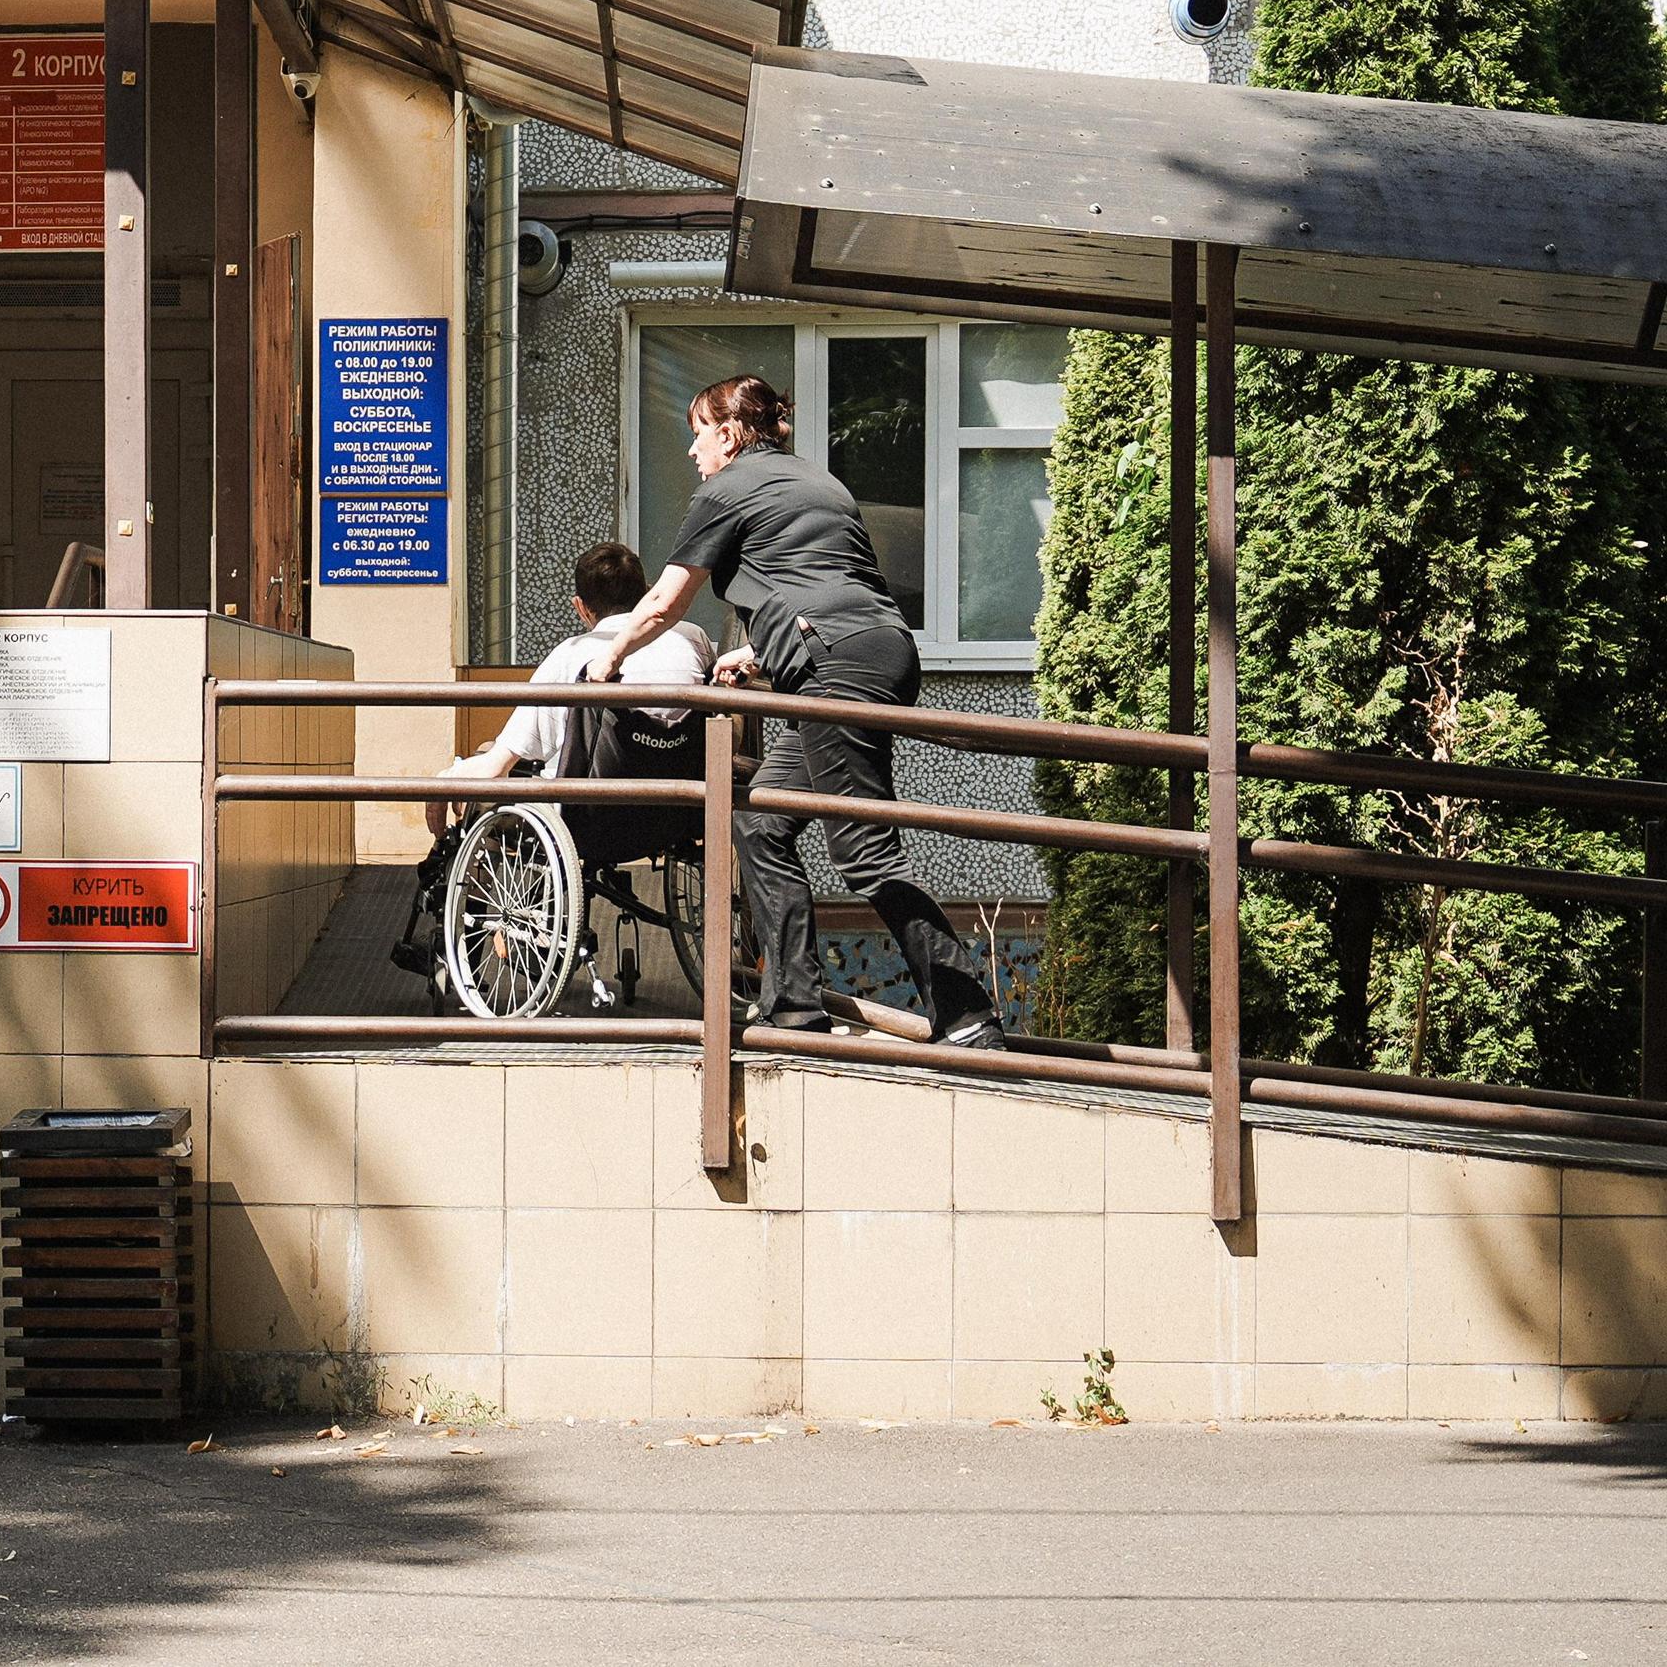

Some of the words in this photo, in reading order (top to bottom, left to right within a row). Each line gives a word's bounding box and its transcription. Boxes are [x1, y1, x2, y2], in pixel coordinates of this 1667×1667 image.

[12, 48, 26, 77] 2
[21, 232, 41, 245] ВХОД
[42, 233, 48, 244] В
[48, 231, 83, 245] ДНЕВНОЙ
[329, 326, 377, 337] РЕЖИМ
[381, 325, 437, 337] РАБОТЫ
[333, 340, 436, 352] ПОЛИКЛИНИКИ:
[335, 359, 342, 368] с
[345, 357, 378, 368] 08.00
[380, 359, 397, 369] до
[401, 357, 433, 367] 19.00
[340, 371, 427, 384] ЕЖЕДНЕВНО.
[342, 386, 424, 401] ВЫХОДНОЙ:
[350, 406, 415, 419] СУББОТА,
[333, 421, 432, 432] ВОСКРЕСЕНЬЕ
[334, 442, 361, 452] ВХОД
[363, 442, 370, 451] В
[372, 442, 432, 452] СТАЦИОНАР
[354, 454, 388, 462] ПОСЛЕ
[391, 454, 415, 462] 18.00
[331, 465, 338, 473] И
[341, 465, 348, 473] В
[350, 465, 408, 474] ВЫХОДНЫЕ
[411, 465, 432, 474] ДНИ
[324, 476, 332, 485] С
[334, 475, 387, 485] ОБРАТНОЙ
[389, 476, 441, 485] СТОРОНЫ!
[337, 502, 378, 511] РЕЖИМ
[381, 502, 429, 511] РАБОТЫ
[337, 514, 428, 523] РЕГИСТРАТУРЫ:
[346, 528, 416, 537] ежедневно
[332, 542, 340, 550] с
[343, 540, 375, 551] 06.30
[377, 542, 395, 551] до
[398, 540, 430, 551] 19.00
[355, 557, 411, 566] выходной:
[327, 568, 371, 578] суббота,
[373, 569, 439, 578] воскресенье
[4, 634, 49, 642] КОРПУС
[73, 878, 145, 895] КУРИТЬ
[47, 905, 168, 929] ЗАПРЕЩЕНО
